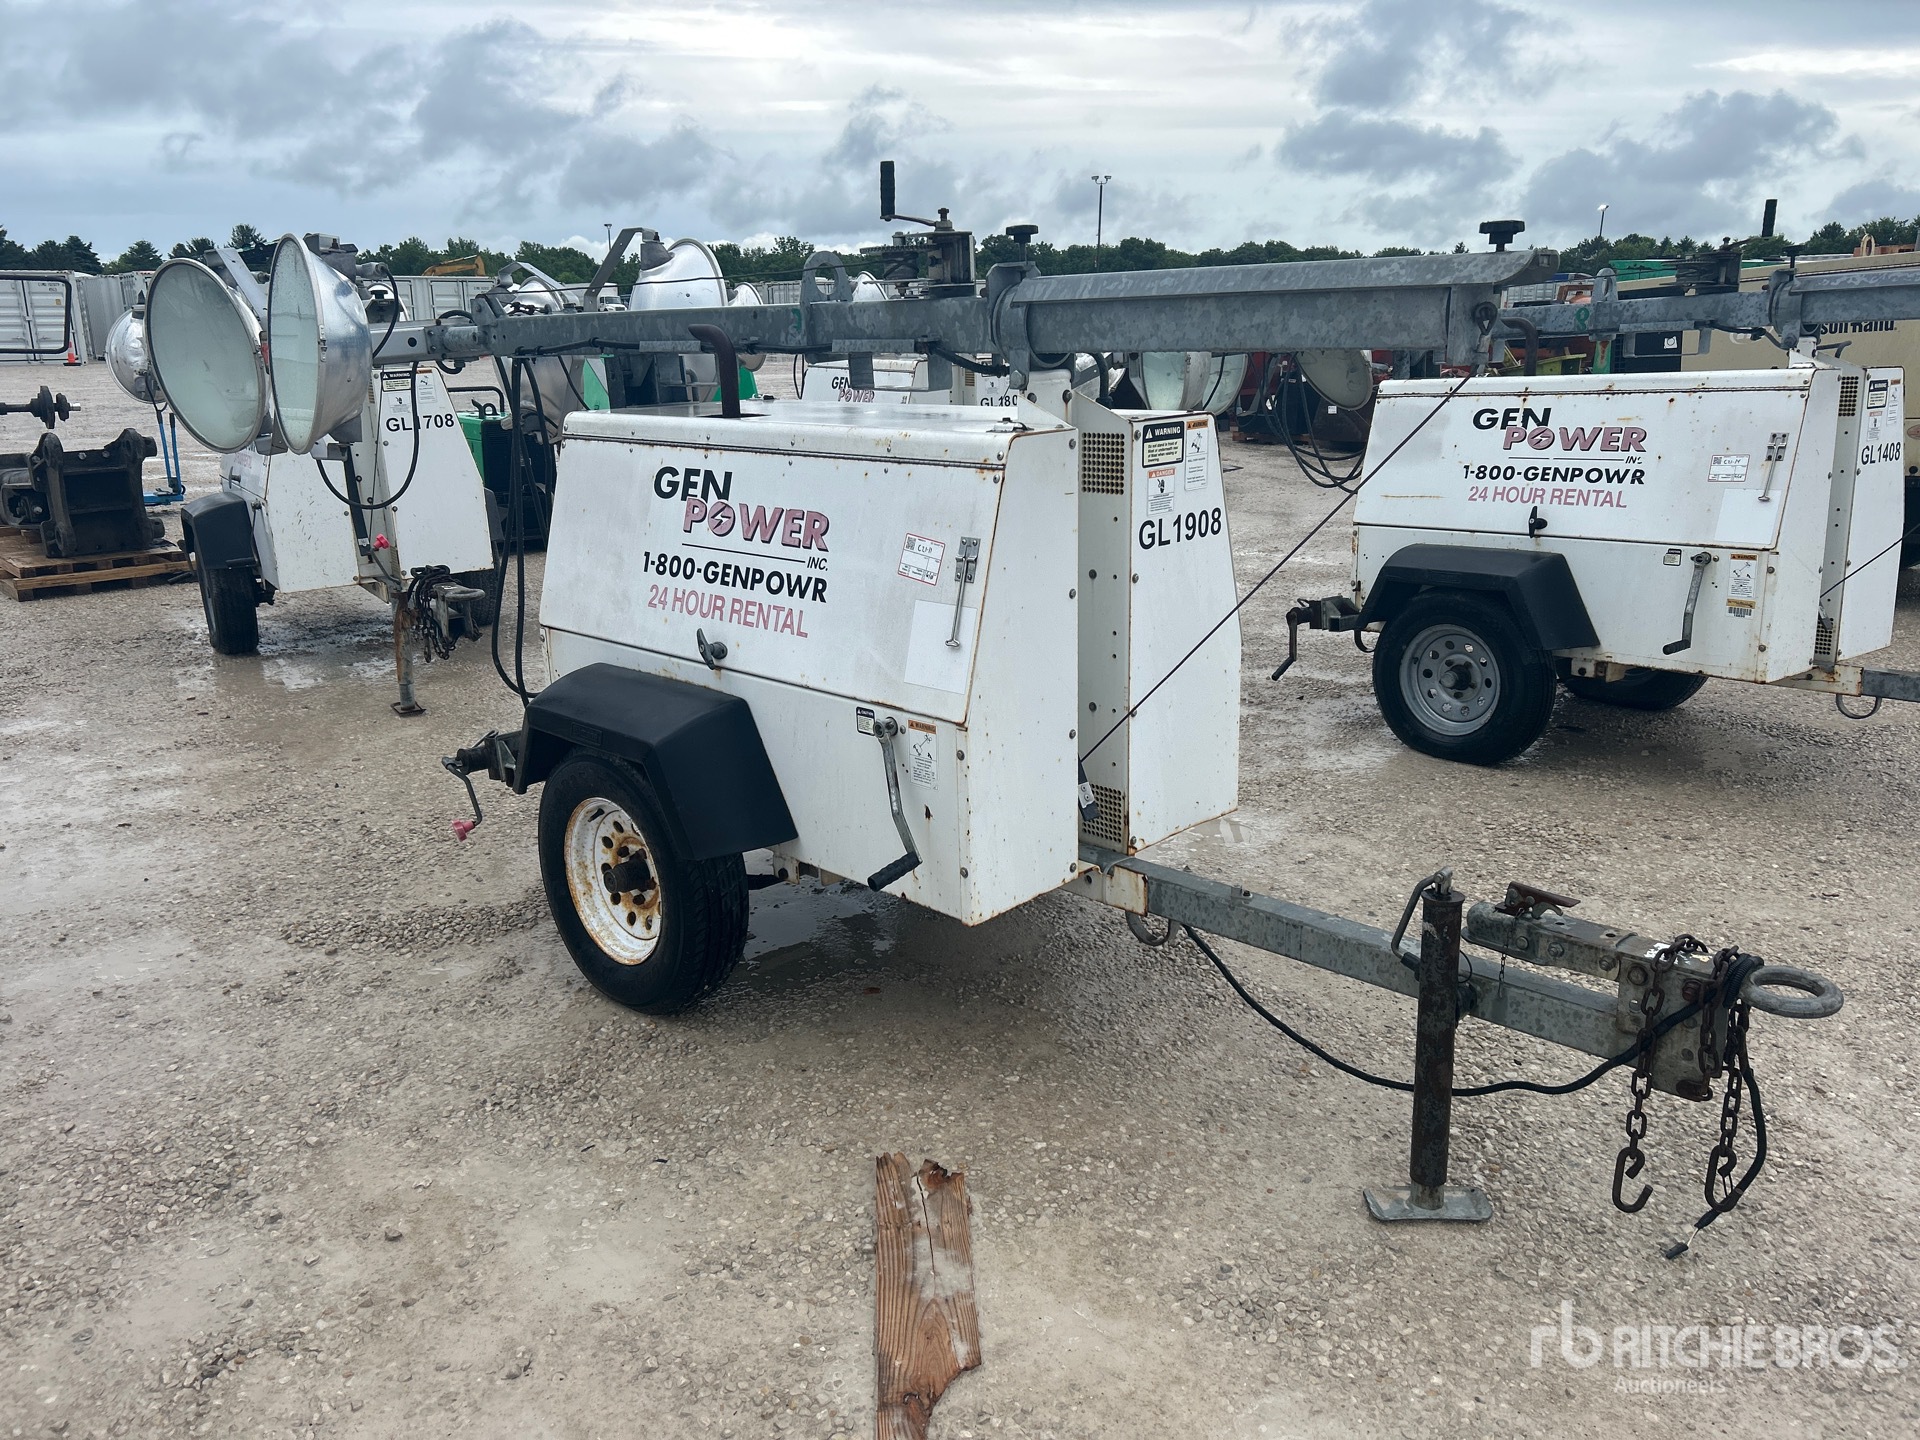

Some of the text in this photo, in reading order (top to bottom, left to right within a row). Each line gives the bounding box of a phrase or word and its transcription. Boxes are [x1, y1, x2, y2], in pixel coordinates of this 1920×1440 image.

[1154, 426, 1180, 436] WARNING
[1473, 408, 1551, 430] GEN
[1503, 426, 1647, 452] POWER
[1861, 442, 1901, 465] GL1408
[654, 466, 733, 503] GEN
[1464, 465, 1645, 484] 1-800-GENPOWR
[1468, 486, 1628, 508] 24 HOUR RENTAL
[683, 497, 829, 552] POWER
[1138, 507, 1222, 550] GL1908
[807, 556, 828, 571] INC.
[643, 551, 827, 603] 1-800-GENPOWR
[648, 584, 808, 638] 24 HOUR RENTAL
